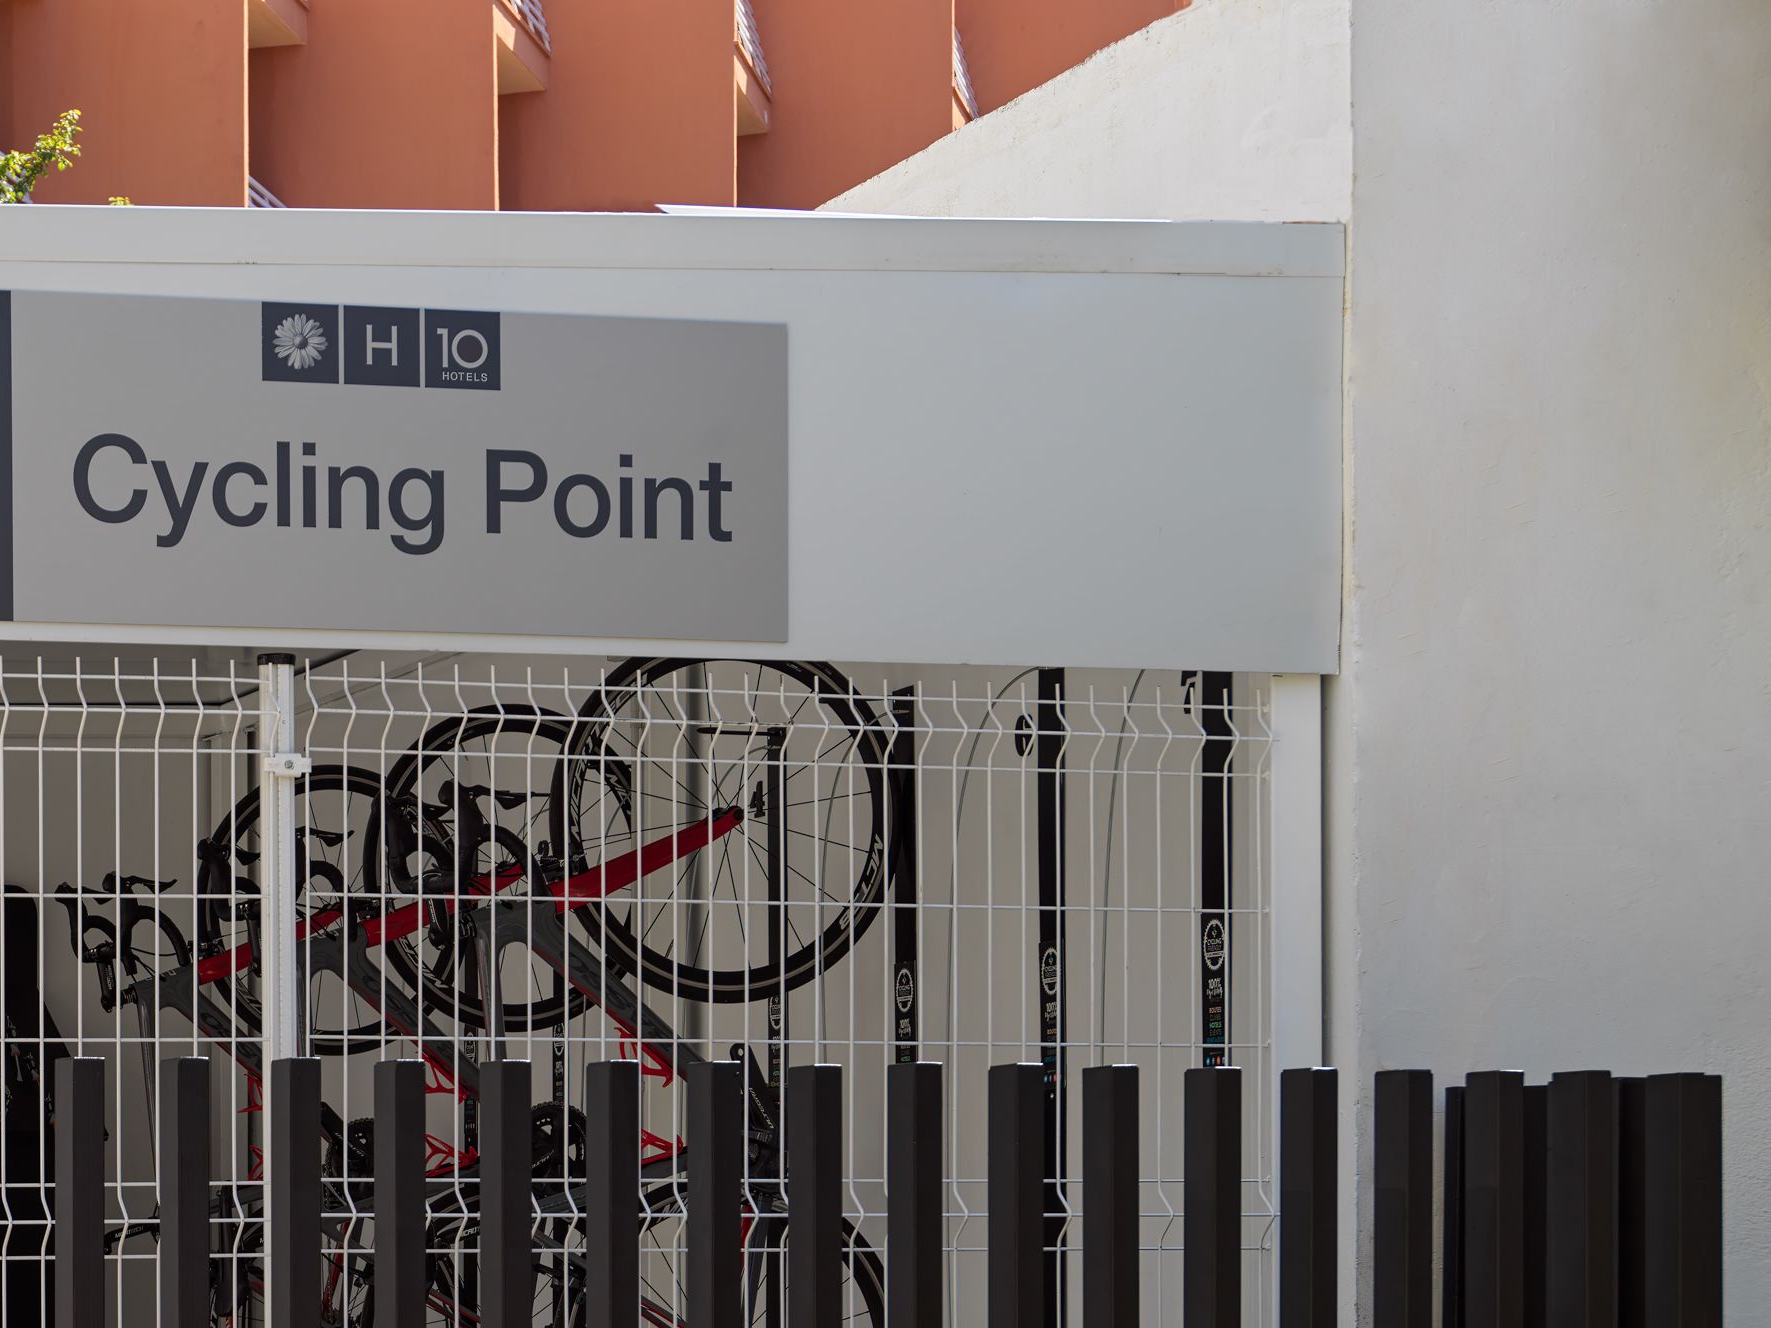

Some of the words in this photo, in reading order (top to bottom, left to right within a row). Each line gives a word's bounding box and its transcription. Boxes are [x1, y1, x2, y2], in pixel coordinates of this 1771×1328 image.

[366, 324, 398, 366] H
[436, 327, 489, 369] 10
[442, 371, 488, 382] HOTELS
[72, 433, 445, 556] Cycling
[485, 448, 733, 543] Point
